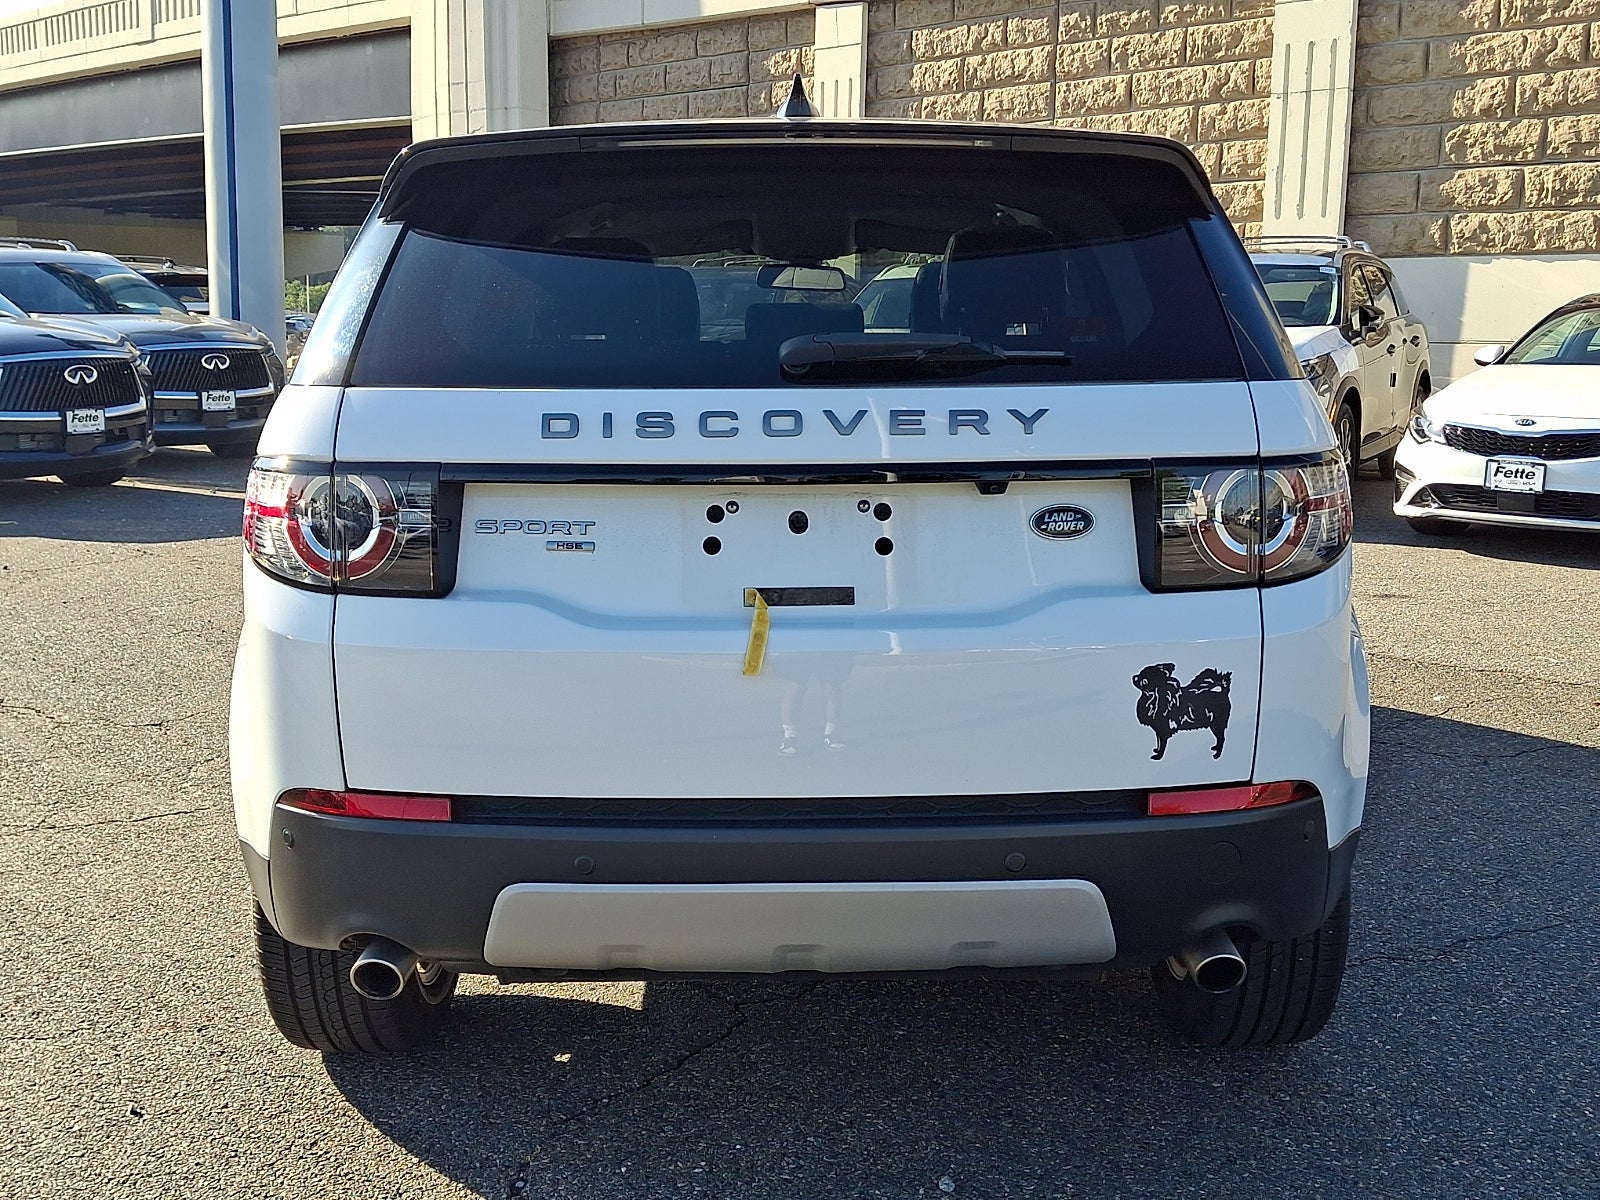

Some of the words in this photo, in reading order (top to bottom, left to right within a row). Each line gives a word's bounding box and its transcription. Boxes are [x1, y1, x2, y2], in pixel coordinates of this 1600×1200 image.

[71, 413, 99, 423] Fette
[541, 408, 1050, 439] DISCOVERY
[1493, 466, 1536, 480] Fette
[1044, 511, 1075, 522] LAND
[474, 519, 596, 535] SPORT
[1047, 521, 1085, 532] ROVER
[556, 542, 584, 550] HSE
